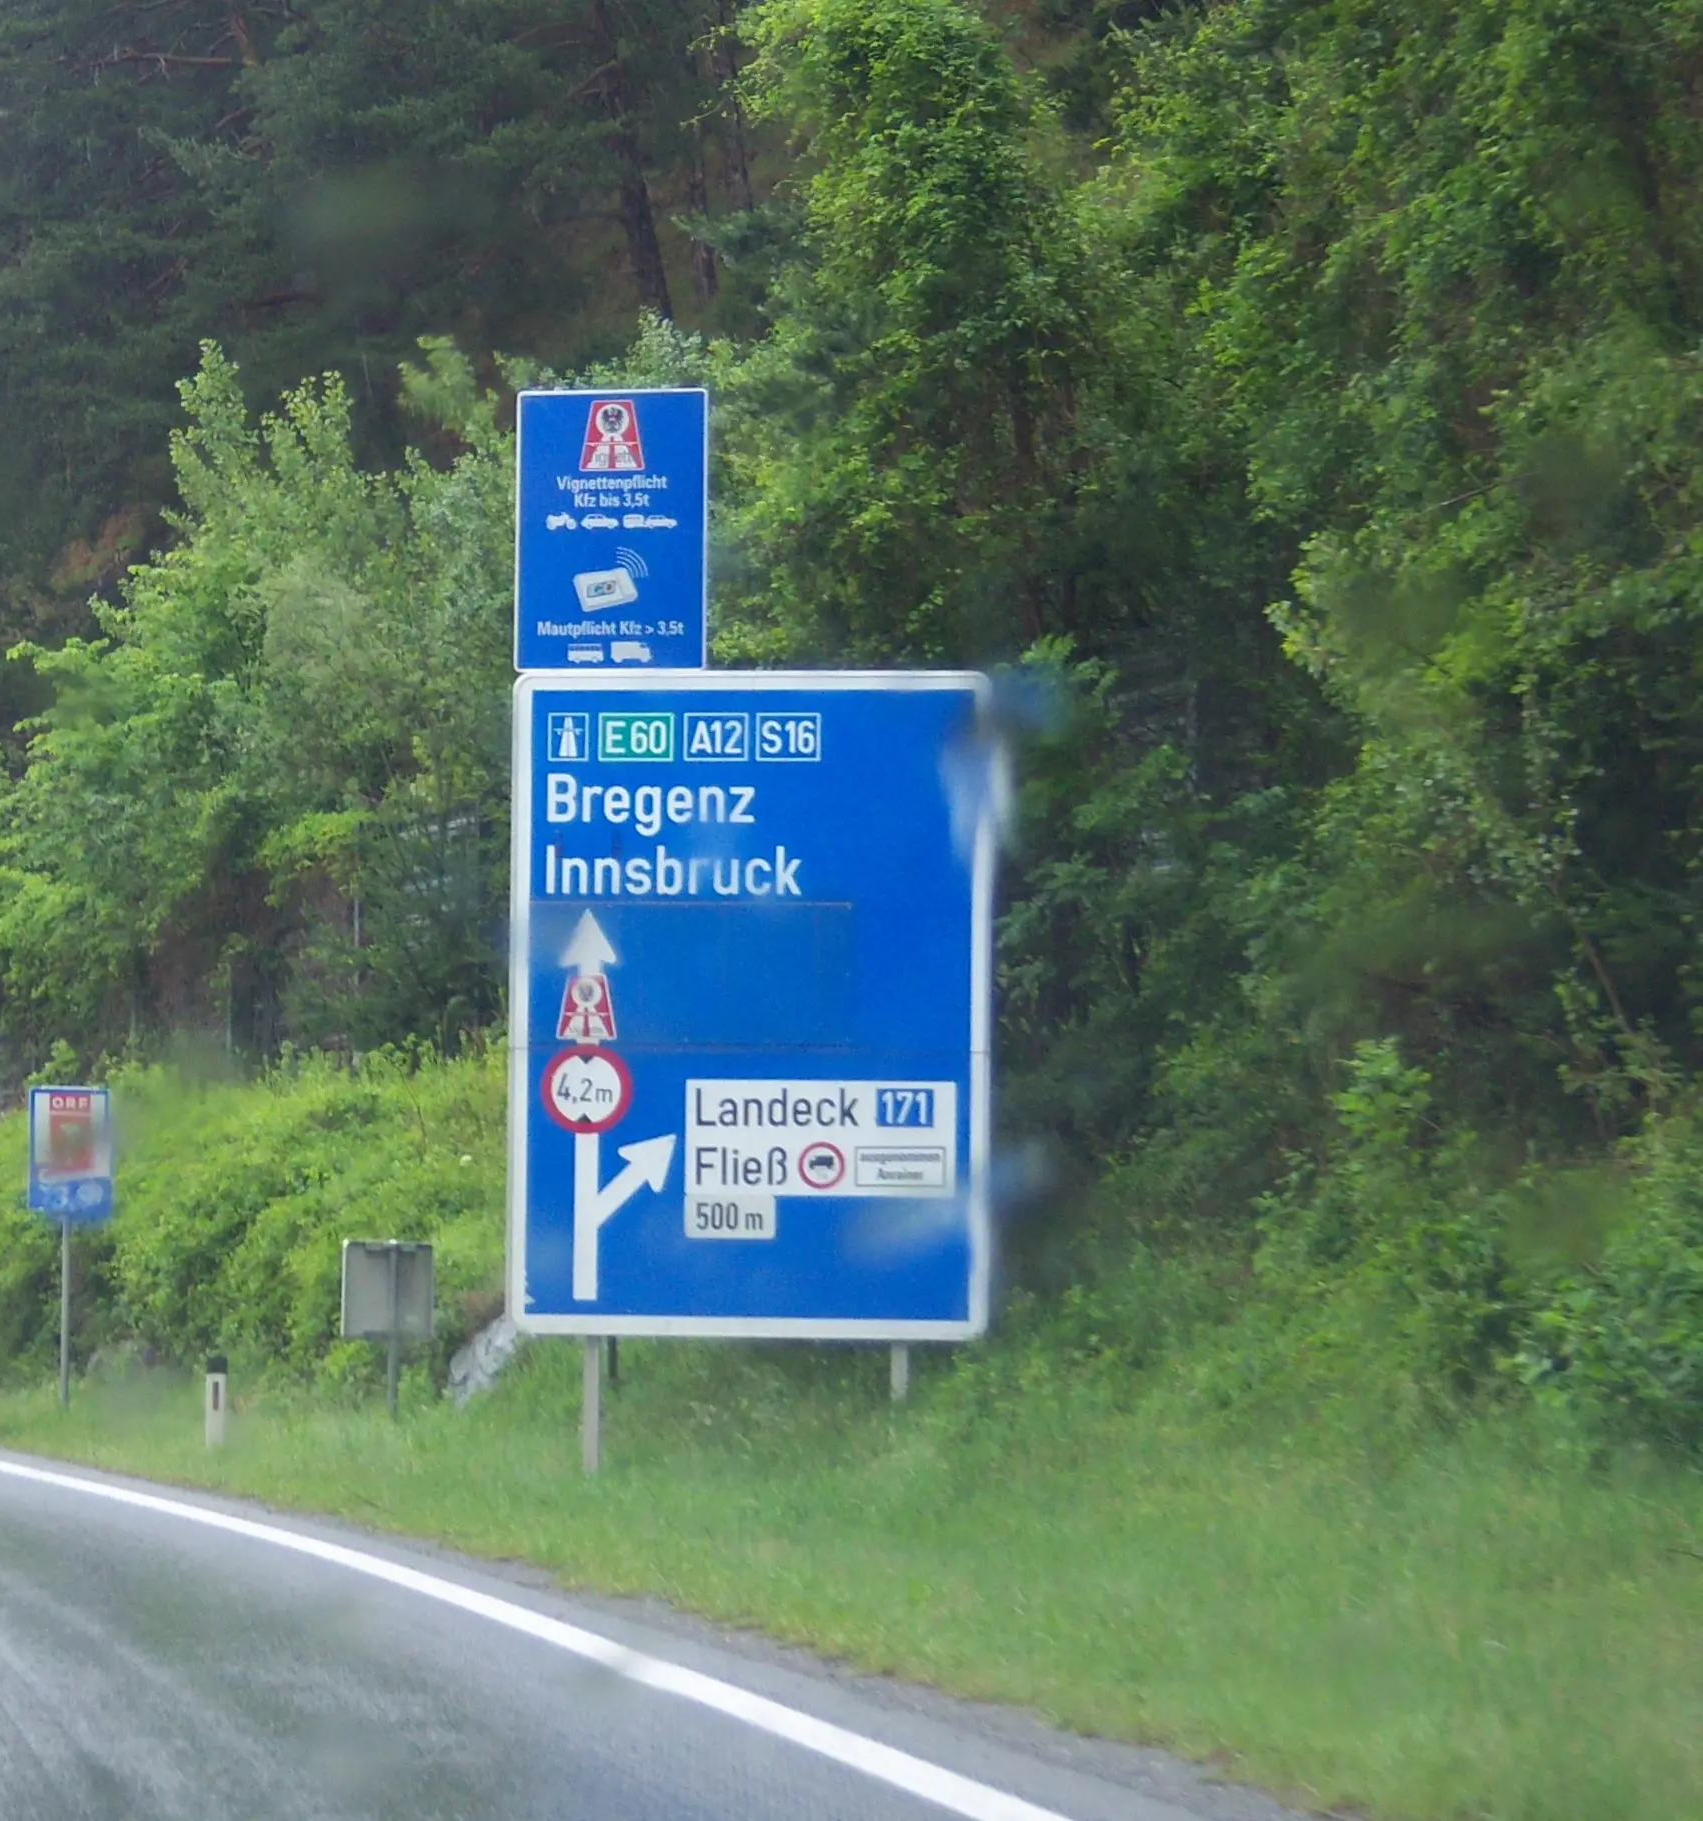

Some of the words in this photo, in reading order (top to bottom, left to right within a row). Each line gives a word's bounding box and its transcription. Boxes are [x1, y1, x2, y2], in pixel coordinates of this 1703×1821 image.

[556, 474, 668, 493] Vignettenpflicht
[574, 493, 596, 508] Kfz
[599, 493, 619, 507] bis
[622, 493, 650, 509] 3,5t
[537, 620, 617, 639] Mautpflicht
[619, 620, 642, 636] Kfz
[689, 720, 743, 754] A12
[760, 720, 816, 754] S16
[546, 773, 756, 837] Bregenz
[545, 845, 802, 896] Innsbruck
[51, 1096, 89, 1109] ORF
[695, 1087, 859, 1127] Landeck
[880, 1090, 929, 1125] 171
[695, 1146, 788, 1186] Fließ
